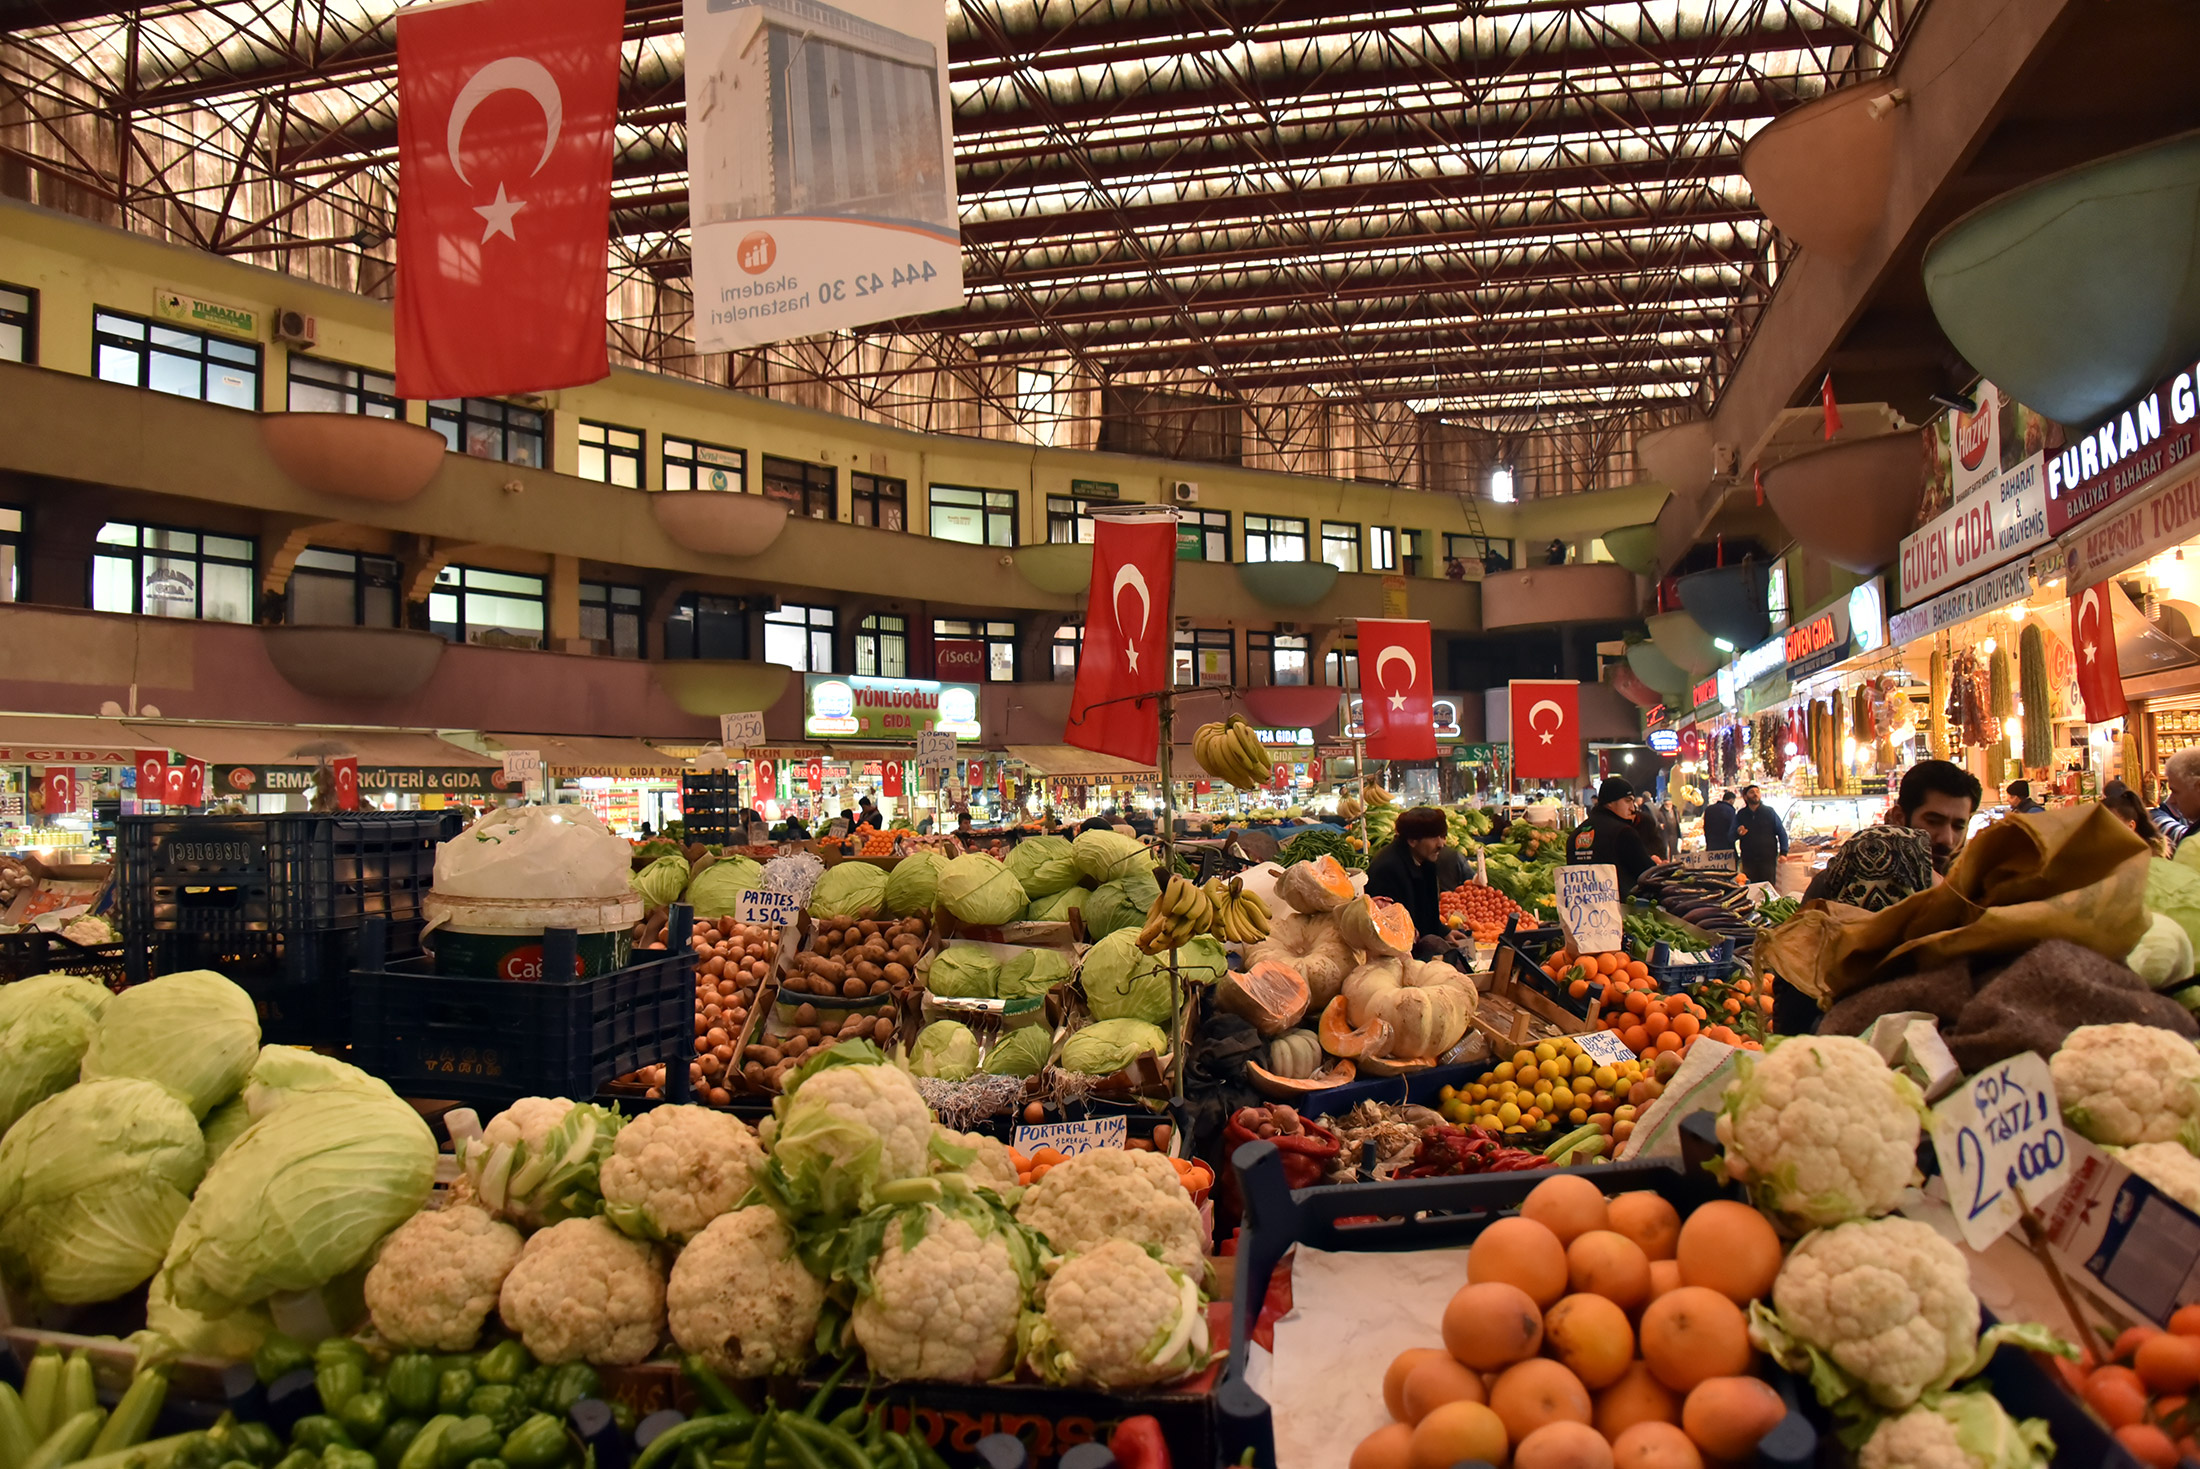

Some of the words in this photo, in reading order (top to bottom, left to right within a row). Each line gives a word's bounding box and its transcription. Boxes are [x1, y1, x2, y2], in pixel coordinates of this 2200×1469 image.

[192, 300, 252, 321] YILMAZLAR
[1958, 410, 1990, 459] Hazra
[2047, 392, 2161, 500] FURKAN
[2000, 463, 2035, 504] BAHARAT
[2066, 479, 2109, 519] BAKLİYAT
[2114, 449, 2163, 494] BAHARAT
[2169, 432, 2193, 465] SÜT
[2015, 498, 2022, 518] &
[1999, 509, 2045, 551] KURUYEMİŞ
[1903, 526, 1948, 594] GÜVEN
[1954, 499, 1996, 568] GIDA
[1932, 593, 1967, 628] BAHARAT
[1968, 590, 1974, 613] &
[1975, 562, 2025, 611] KURUYEMİŞ
[1785, 625, 1813, 664] GÜVEN
[1811, 613, 1835, 651] GIDA
[853, 685, 939, 710] YÜNLÜOĞLU
[883, 713, 912, 729] GIDA
[1253, 729, 1273, 744] YSA
[1275, 729, 1298, 744] GIDA
[24, 750, 127, 762] GIDA
[1274, 750, 1293, 762] GIDA
[266, 771, 312, 788] ERMA
[356, 769, 424, 787] RKÜTERİ
[427, 772, 438, 787] &
[441, 771, 481, 788] GIDA
[552, 766, 622, 777] TEMİZOĞLU
[629, 767, 656, 777] GIDA
[660, 767, 685, 777] PAZ
[1053, 775, 1088, 785] KONYA
[1094, 775, 1114, 784] BAL
[743, 890, 794, 906] PATATES
